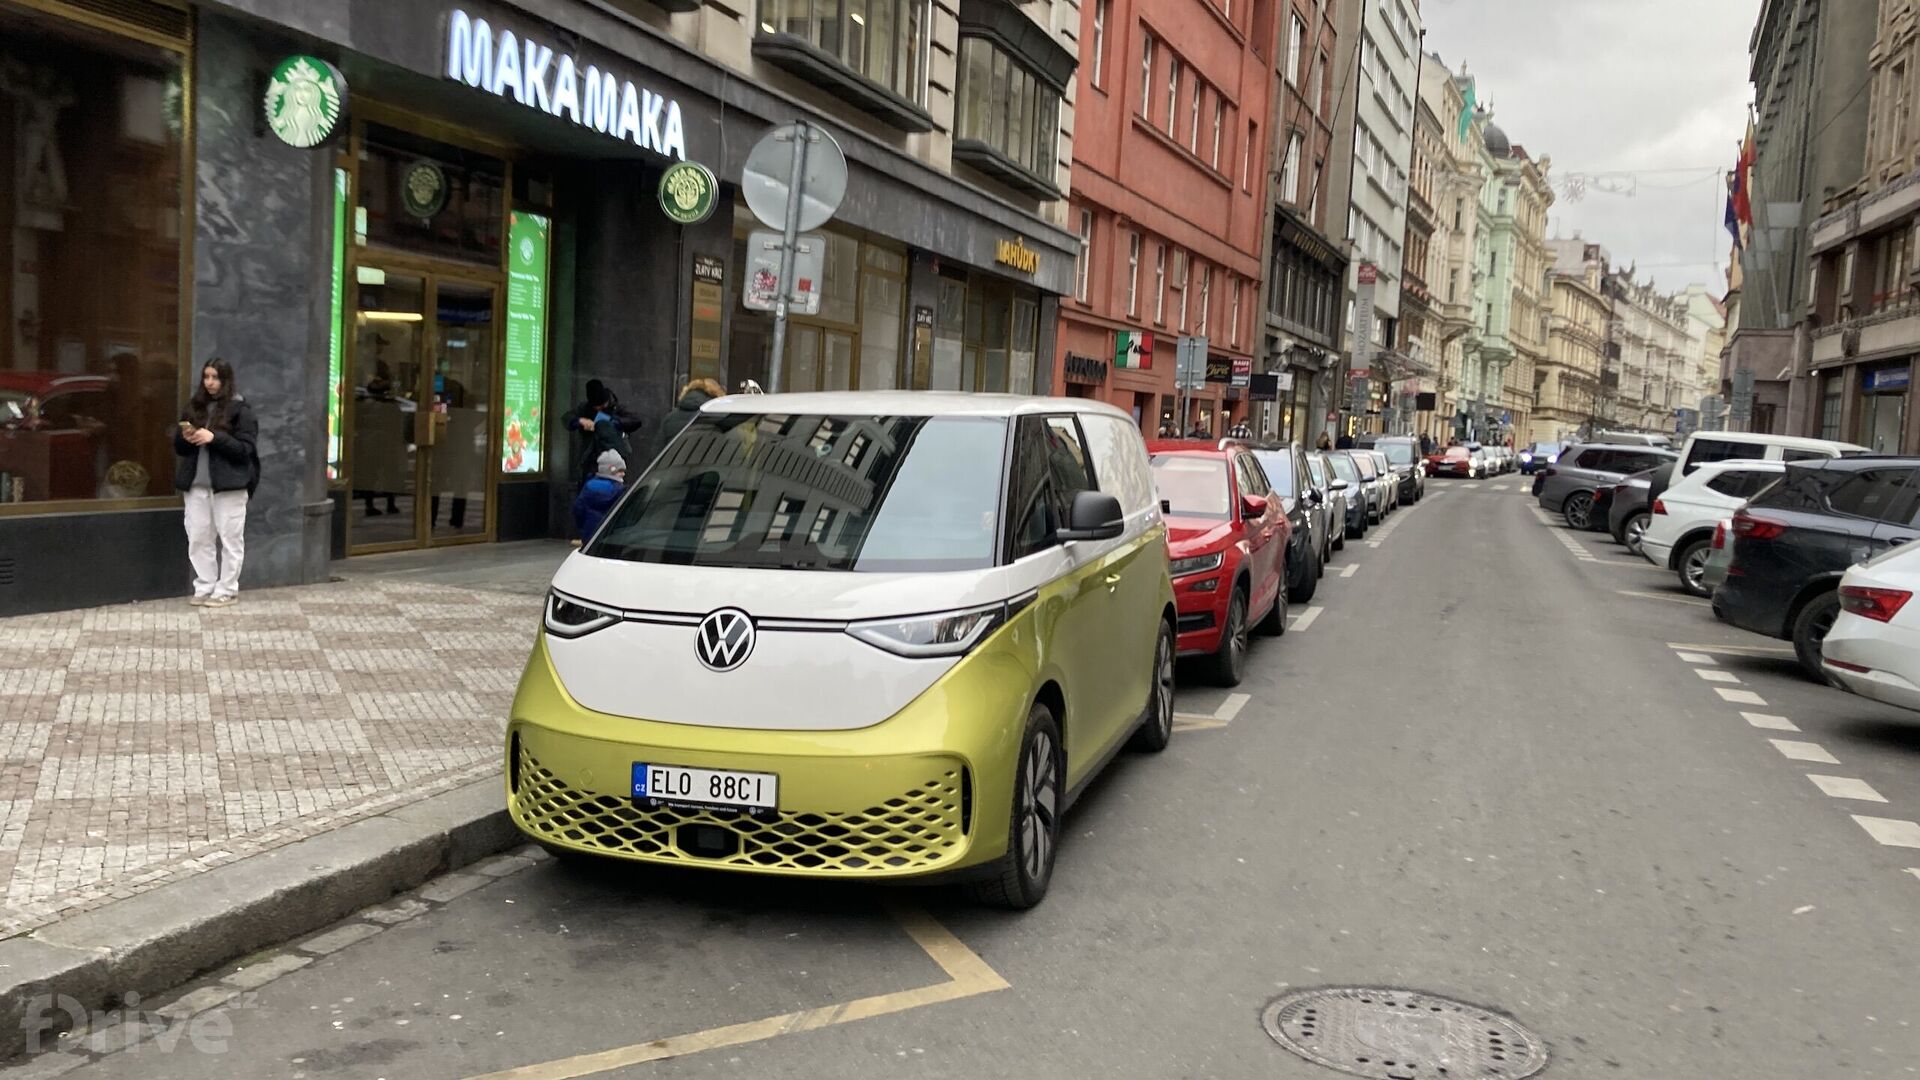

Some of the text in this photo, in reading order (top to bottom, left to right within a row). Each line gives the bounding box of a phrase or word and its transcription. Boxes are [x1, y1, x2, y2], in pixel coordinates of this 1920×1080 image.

[1357, 298, 1369, 357] MOZARTEUM
[697, 609, 753, 669] VW
[635, 783, 646, 793] CZ
